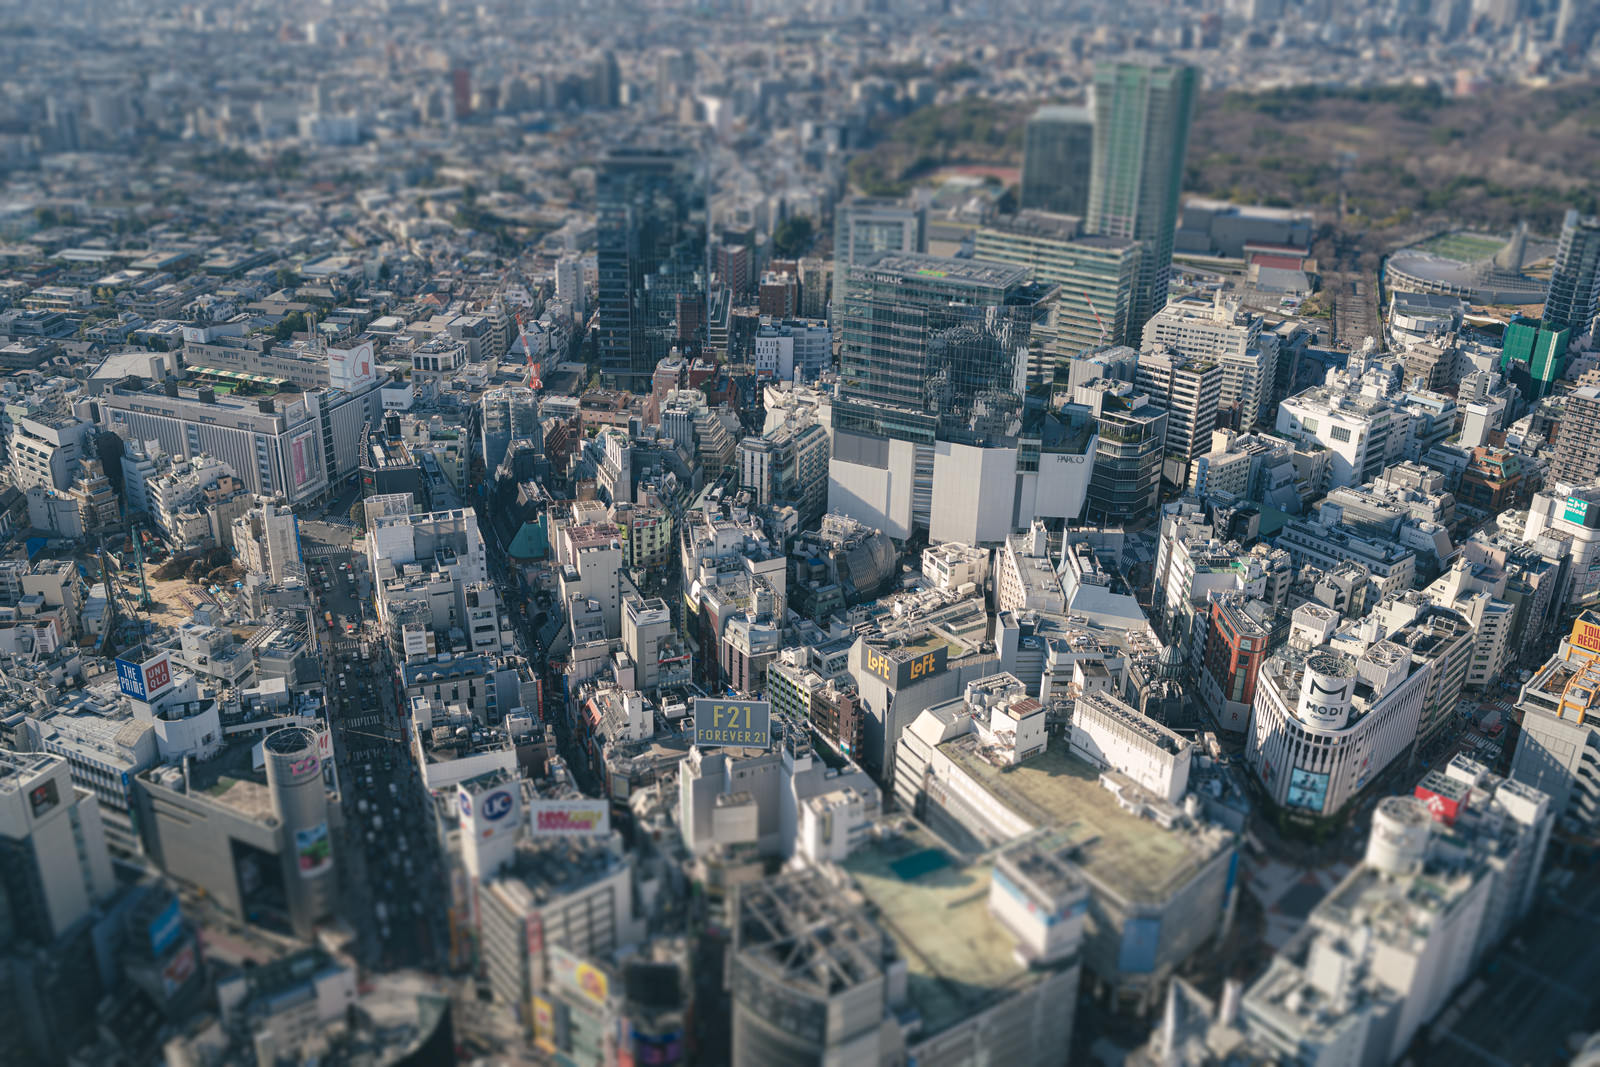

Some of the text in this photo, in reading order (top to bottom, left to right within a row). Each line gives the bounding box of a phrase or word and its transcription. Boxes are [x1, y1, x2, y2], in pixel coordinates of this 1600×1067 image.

[876, 273, 904, 285] HULIC
[1056, 455, 1085, 464] PARCO
[1567, 498, 1588, 510] ニトリ
[1566, 507, 1586, 517] NITORI
[122, 664, 137, 681] THE
[148, 663, 165, 679] UNI
[120, 676, 144, 696] PRIME
[150, 673, 168, 689] QLO
[1305, 701, 1343, 716] MODI
[713, 705, 751, 729] F21
[698, 729, 766, 743] FOREVER 21
